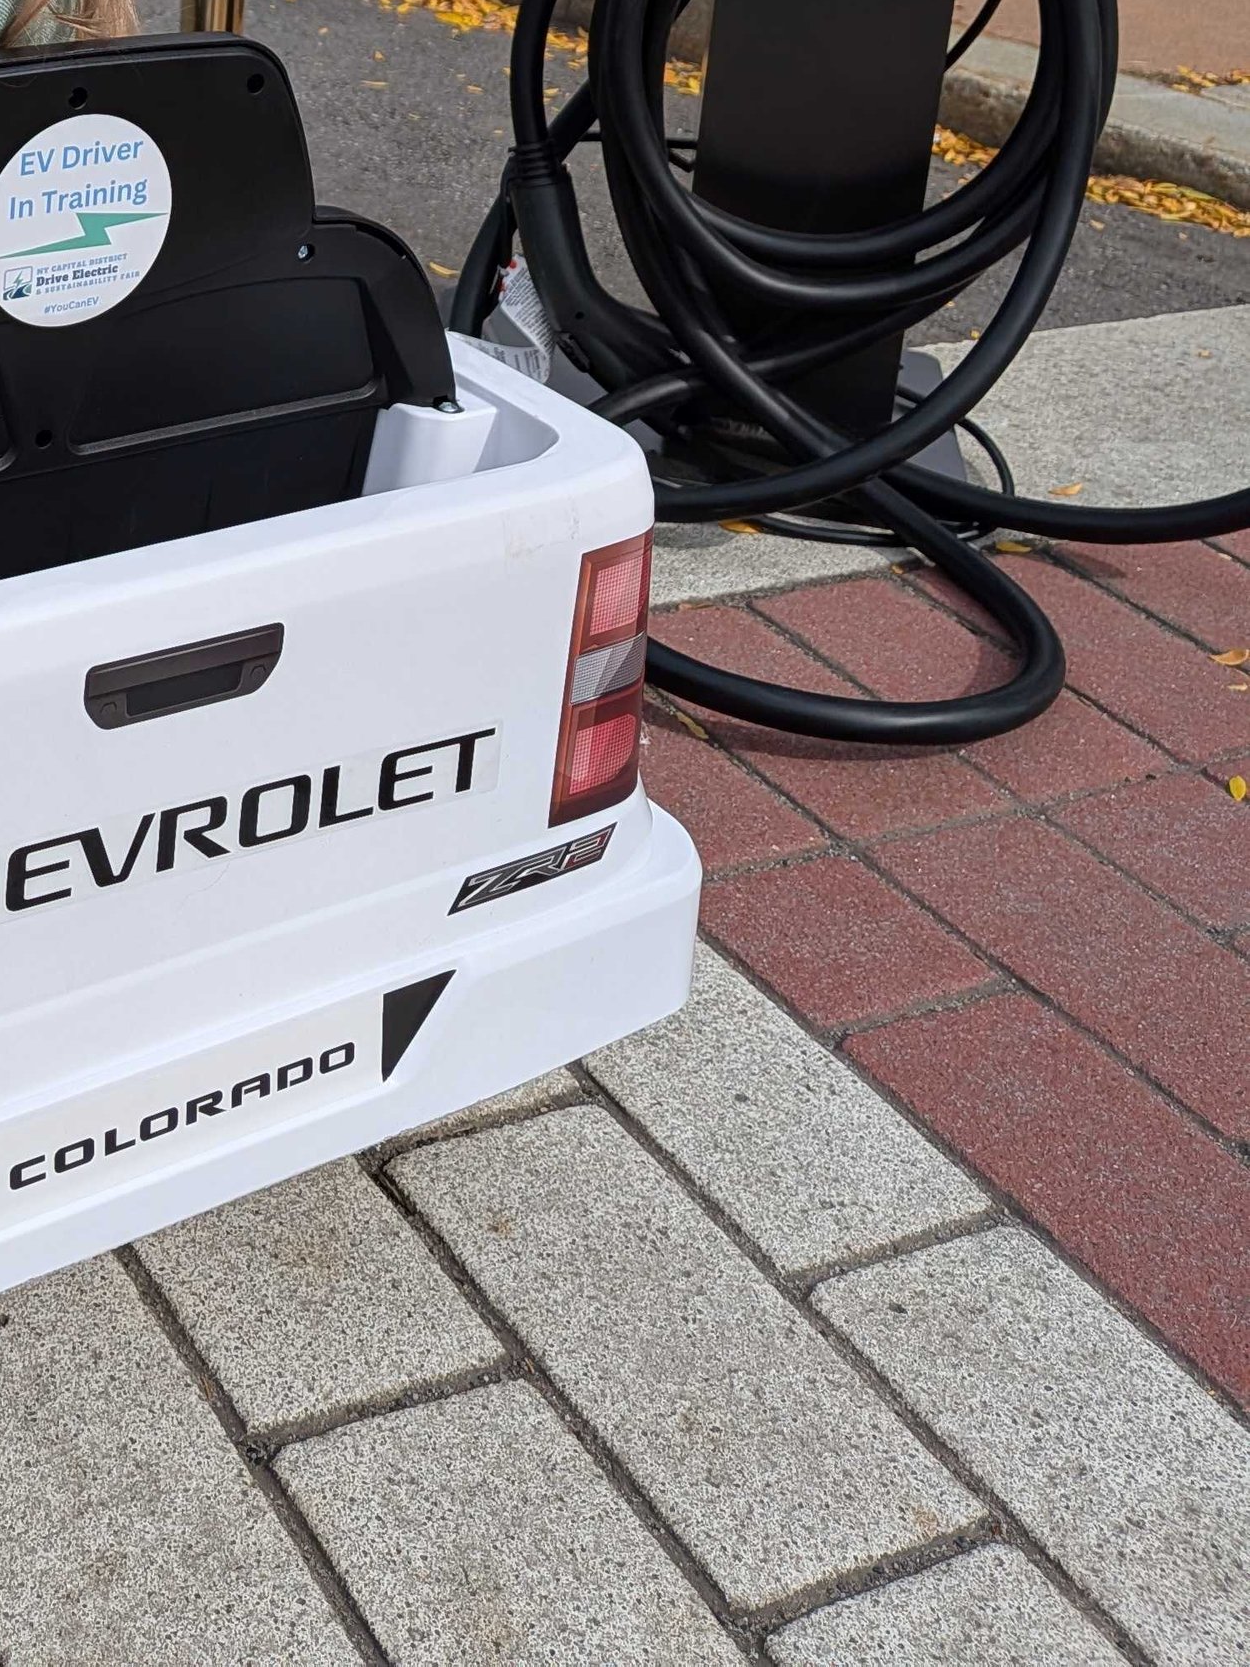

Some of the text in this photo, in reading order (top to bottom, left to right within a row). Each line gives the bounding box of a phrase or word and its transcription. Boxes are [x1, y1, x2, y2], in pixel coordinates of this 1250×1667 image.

[20, 140, 144, 176] EV Driver
[9, 179, 148, 220] In Training
[36, 253, 128, 275] NY CAPITAL DISTRICT
[36, 264, 119, 287] Drive Electric
[44, 275, 118, 294] SUSTAINABILITY
[120, 271, 140, 282] FAIR
[44, 296, 100, 315] #YouCanEV
[8, 1040, 357, 1191] COLORADO
